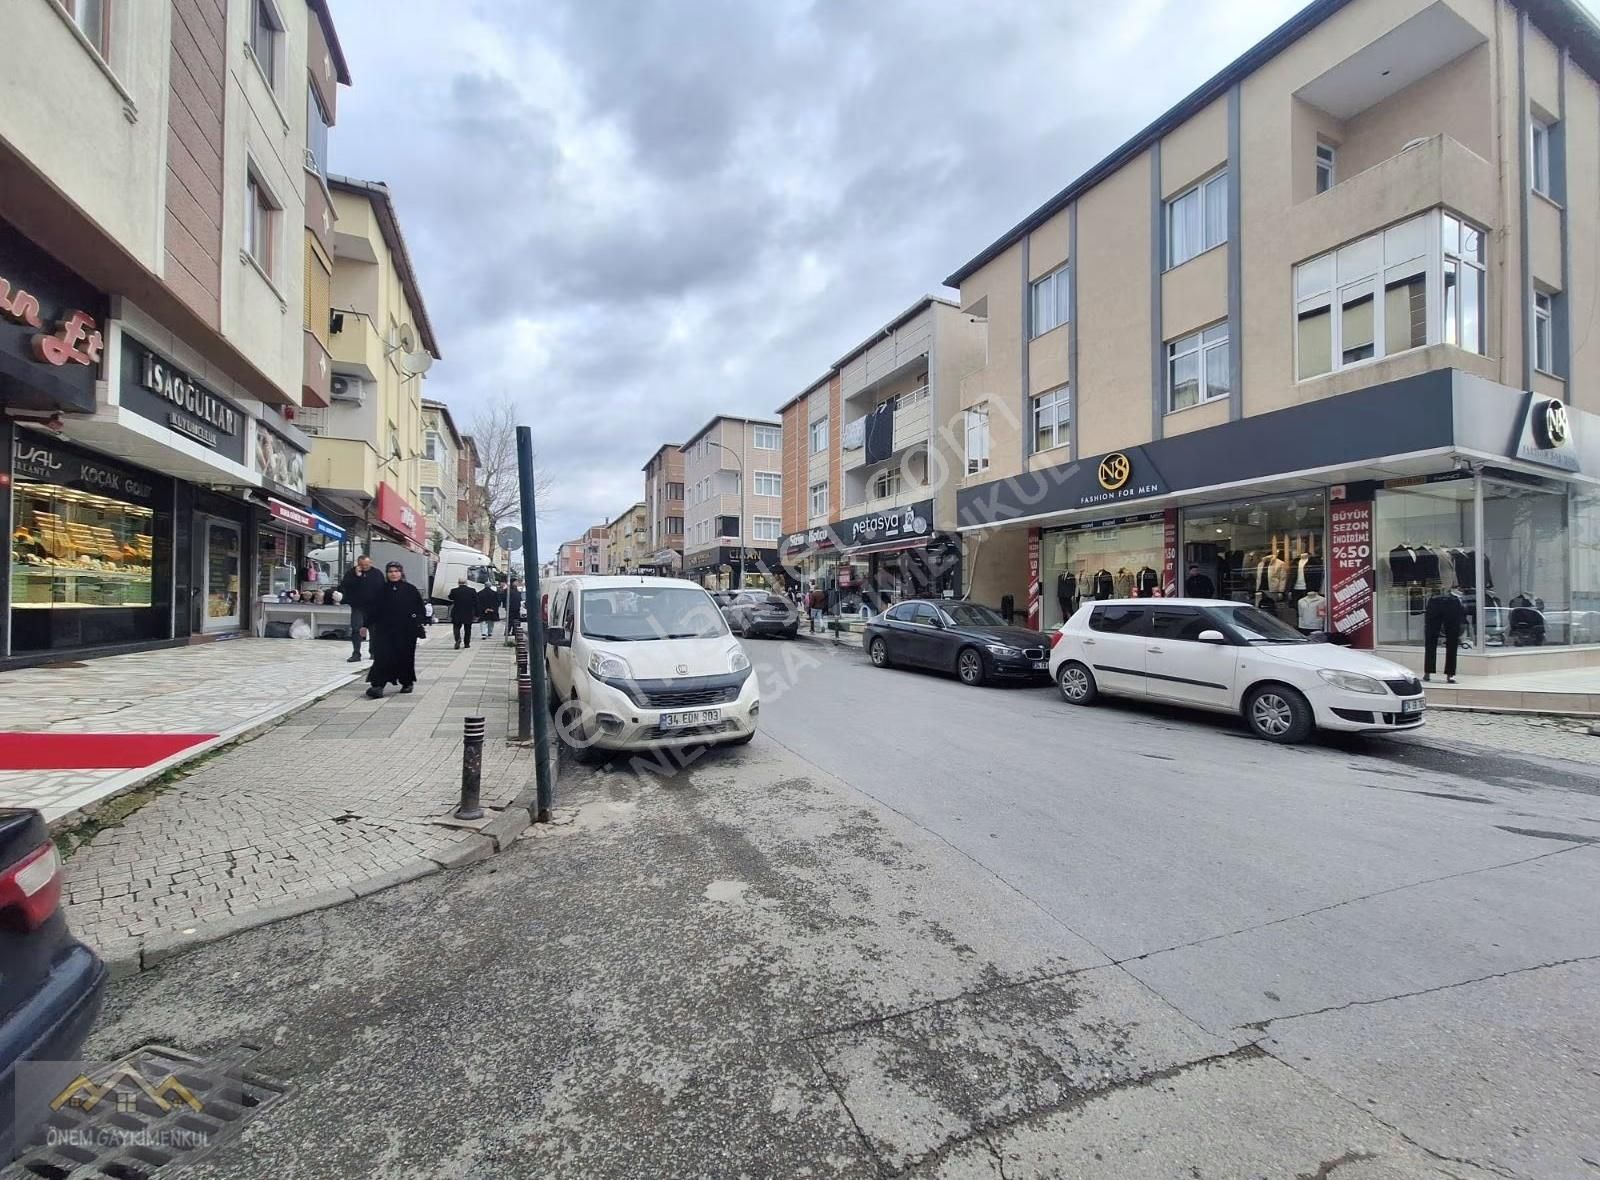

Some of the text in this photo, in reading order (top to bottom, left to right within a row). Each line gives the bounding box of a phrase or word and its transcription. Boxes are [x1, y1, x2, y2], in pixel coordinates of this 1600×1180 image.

[42, 310, 104, 366] Et
[144, 353, 237, 436] İSAOĞULLARI
[1101, 456, 1128, 481] N8
[1080, 484, 1159, 504] FASHION FOR MEN
[1332, 509, 1369, 521] BÜYÜK
[852, 514, 899, 541] petasya
[1332, 521, 1369, 533] SEZON
[1332, 532, 1369, 544] İNDİRİMİ
[1332, 545, 1370, 559] %50
[1339, 559, 1362, 568] NET
[667, 715, 678, 725] 34
[702, 711, 719, 721] 903
